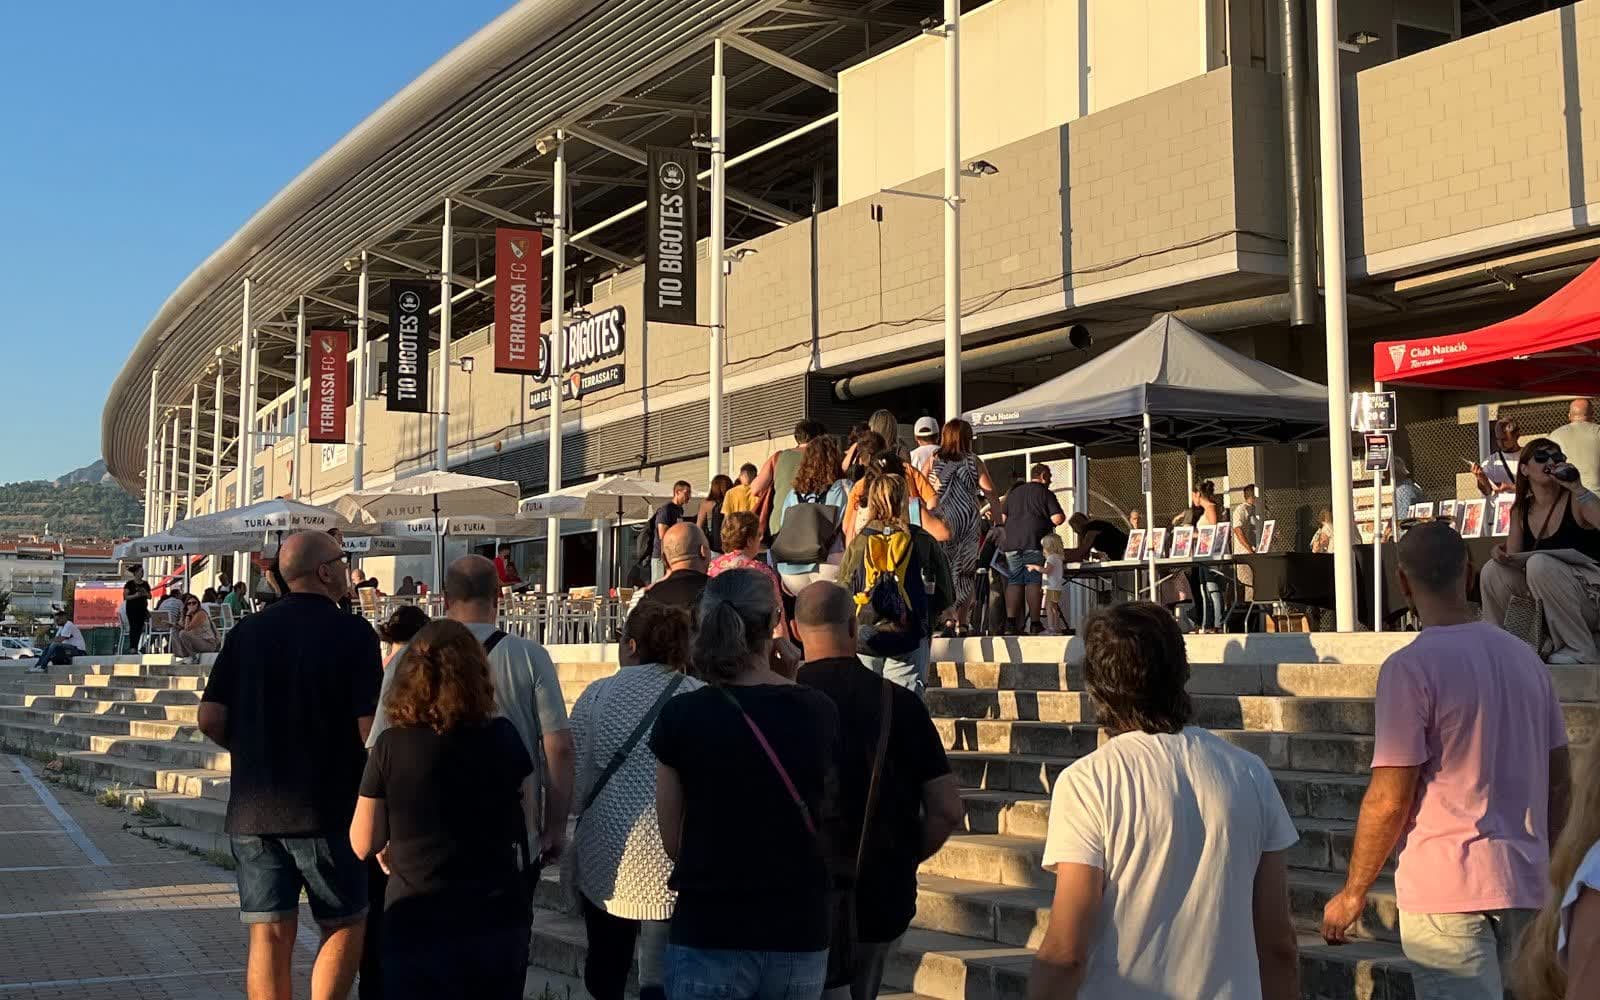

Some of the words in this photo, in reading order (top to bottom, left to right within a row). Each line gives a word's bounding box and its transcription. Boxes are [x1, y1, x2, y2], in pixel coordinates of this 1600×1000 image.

[658, 193, 684, 274] BIGOTES
[510, 262, 527, 281] FC
[658, 277, 683, 308] TIO
[509, 284, 527, 362] TERRASSA
[398, 315, 419, 375] BIGOTES
[568, 308, 619, 367] BIGOTES
[1410, 346, 1431, 358] Club
[1432, 341, 1468, 355] Natació
[321, 356, 336, 371] FC
[581, 371, 610, 389] TERRASSA
[610, 368, 619, 380] FC
[397, 377, 417, 401] TIO
[320, 373, 335, 434] TERRASSA
[245, 519, 272, 528] TURIA
[303, 517, 325, 525] TURIA
[407, 523, 432, 532] TURIA
[464, 523, 486, 532] TURIA
[153, 543, 184, 552] TURIA
